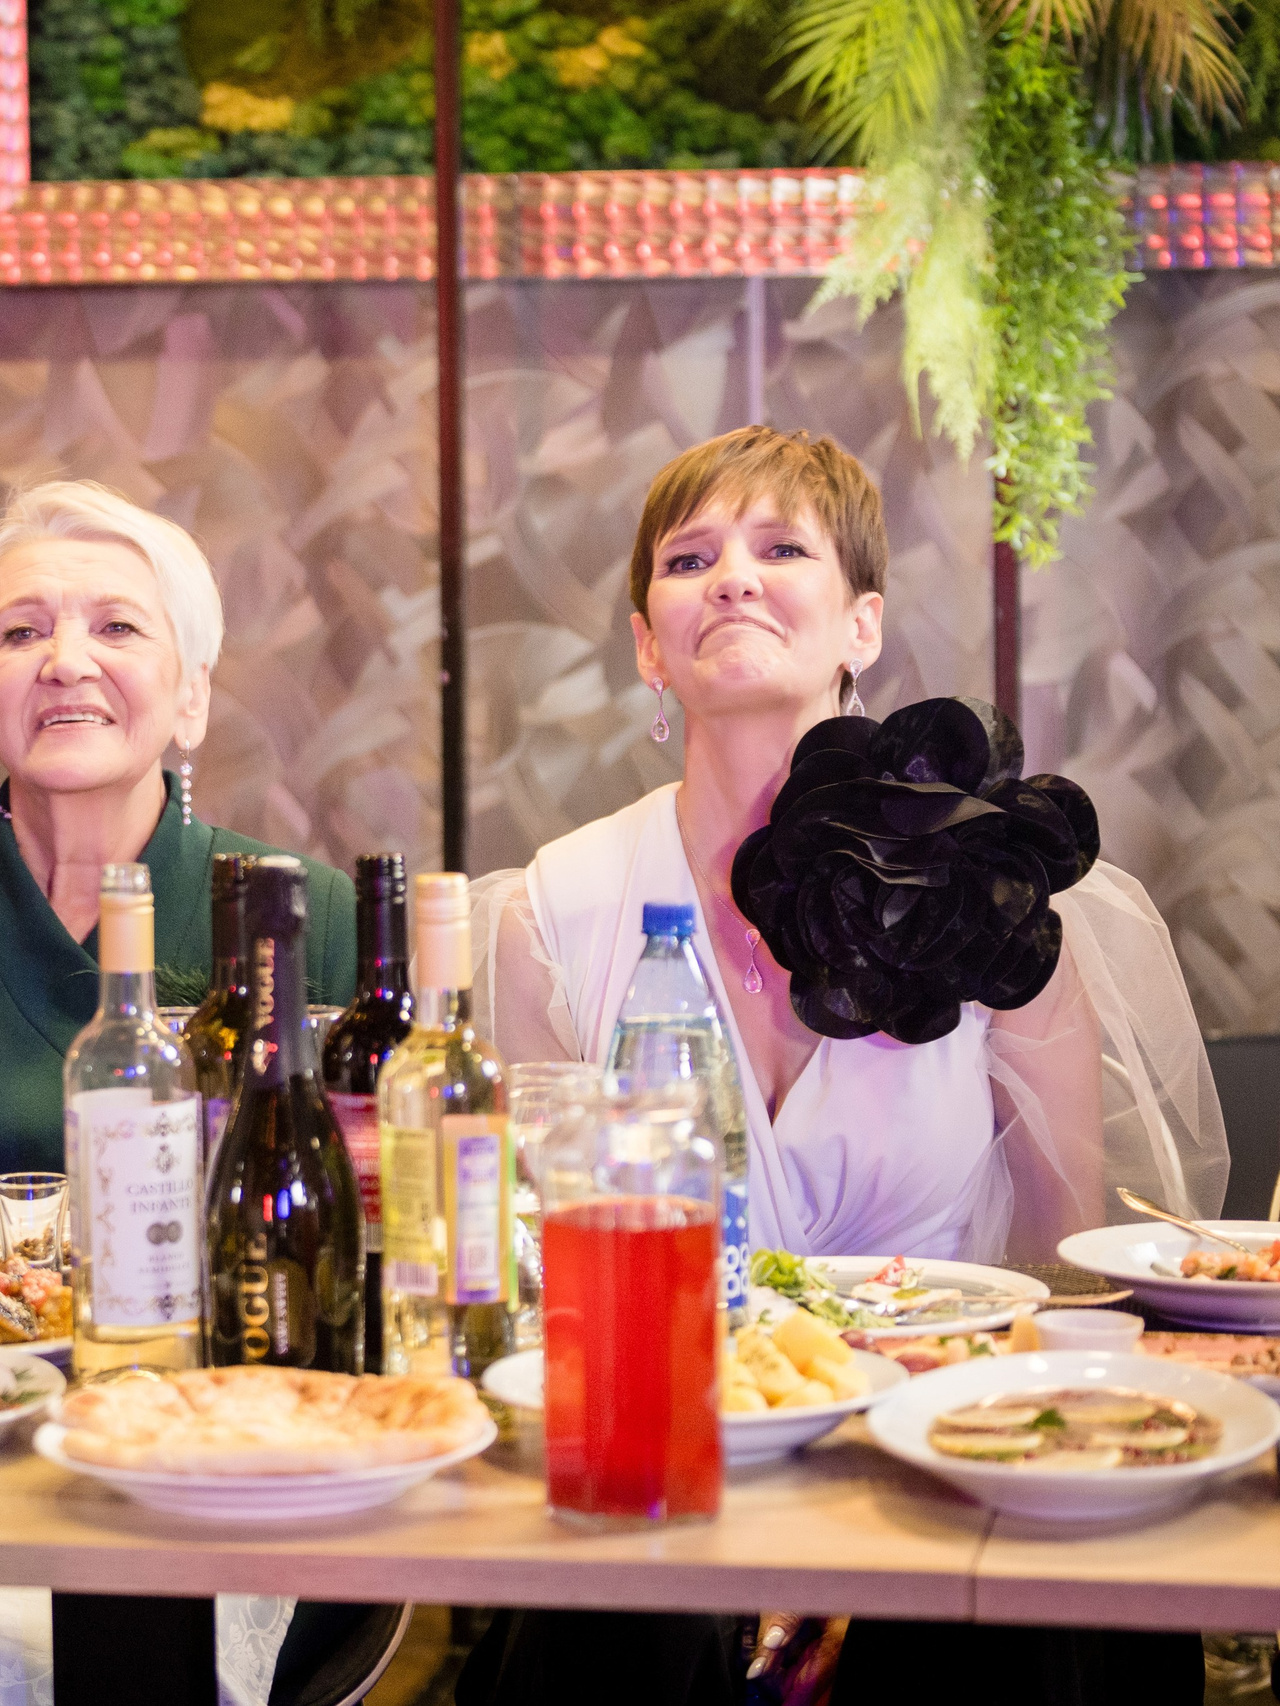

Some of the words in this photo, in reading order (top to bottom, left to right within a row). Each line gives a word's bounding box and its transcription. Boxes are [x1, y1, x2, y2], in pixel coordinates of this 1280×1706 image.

[253, 937, 276, 1030] VOGUE
[125, 1179, 194, 1195] CASTILLO
[239, 1232, 270, 1364] OGUE
